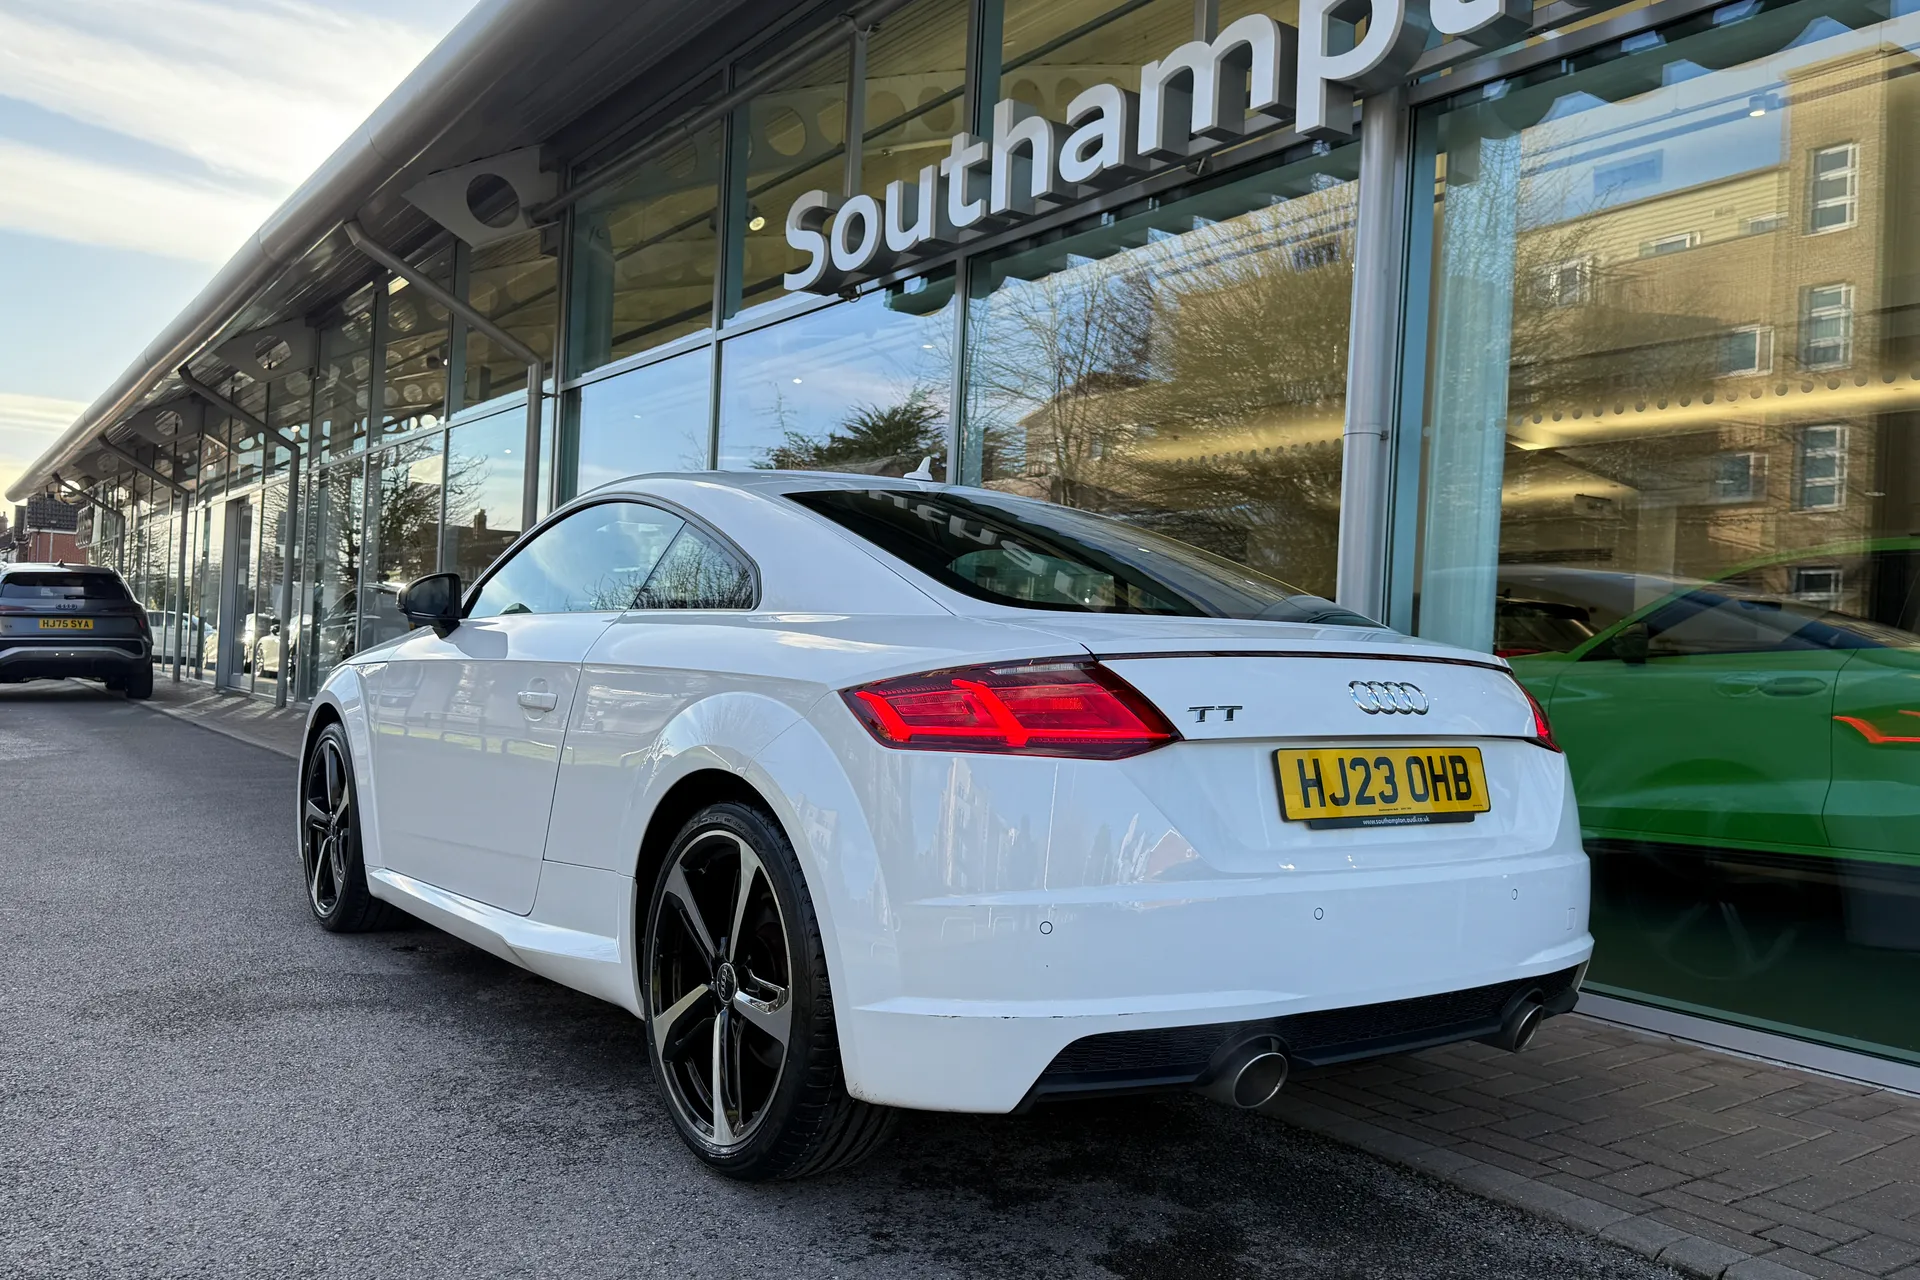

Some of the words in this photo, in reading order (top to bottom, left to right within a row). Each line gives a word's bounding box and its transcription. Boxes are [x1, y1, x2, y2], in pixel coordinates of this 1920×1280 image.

[42, 620, 69, 628] HJ75
[70, 620, 90, 628] SYA
[1187, 705, 1243, 723] TT
[1297, 756, 1399, 809] HJ23
[1405, 755, 1472, 803] OHB
[1362, 815, 1430, 825] www.southampton.audi.co.uk
